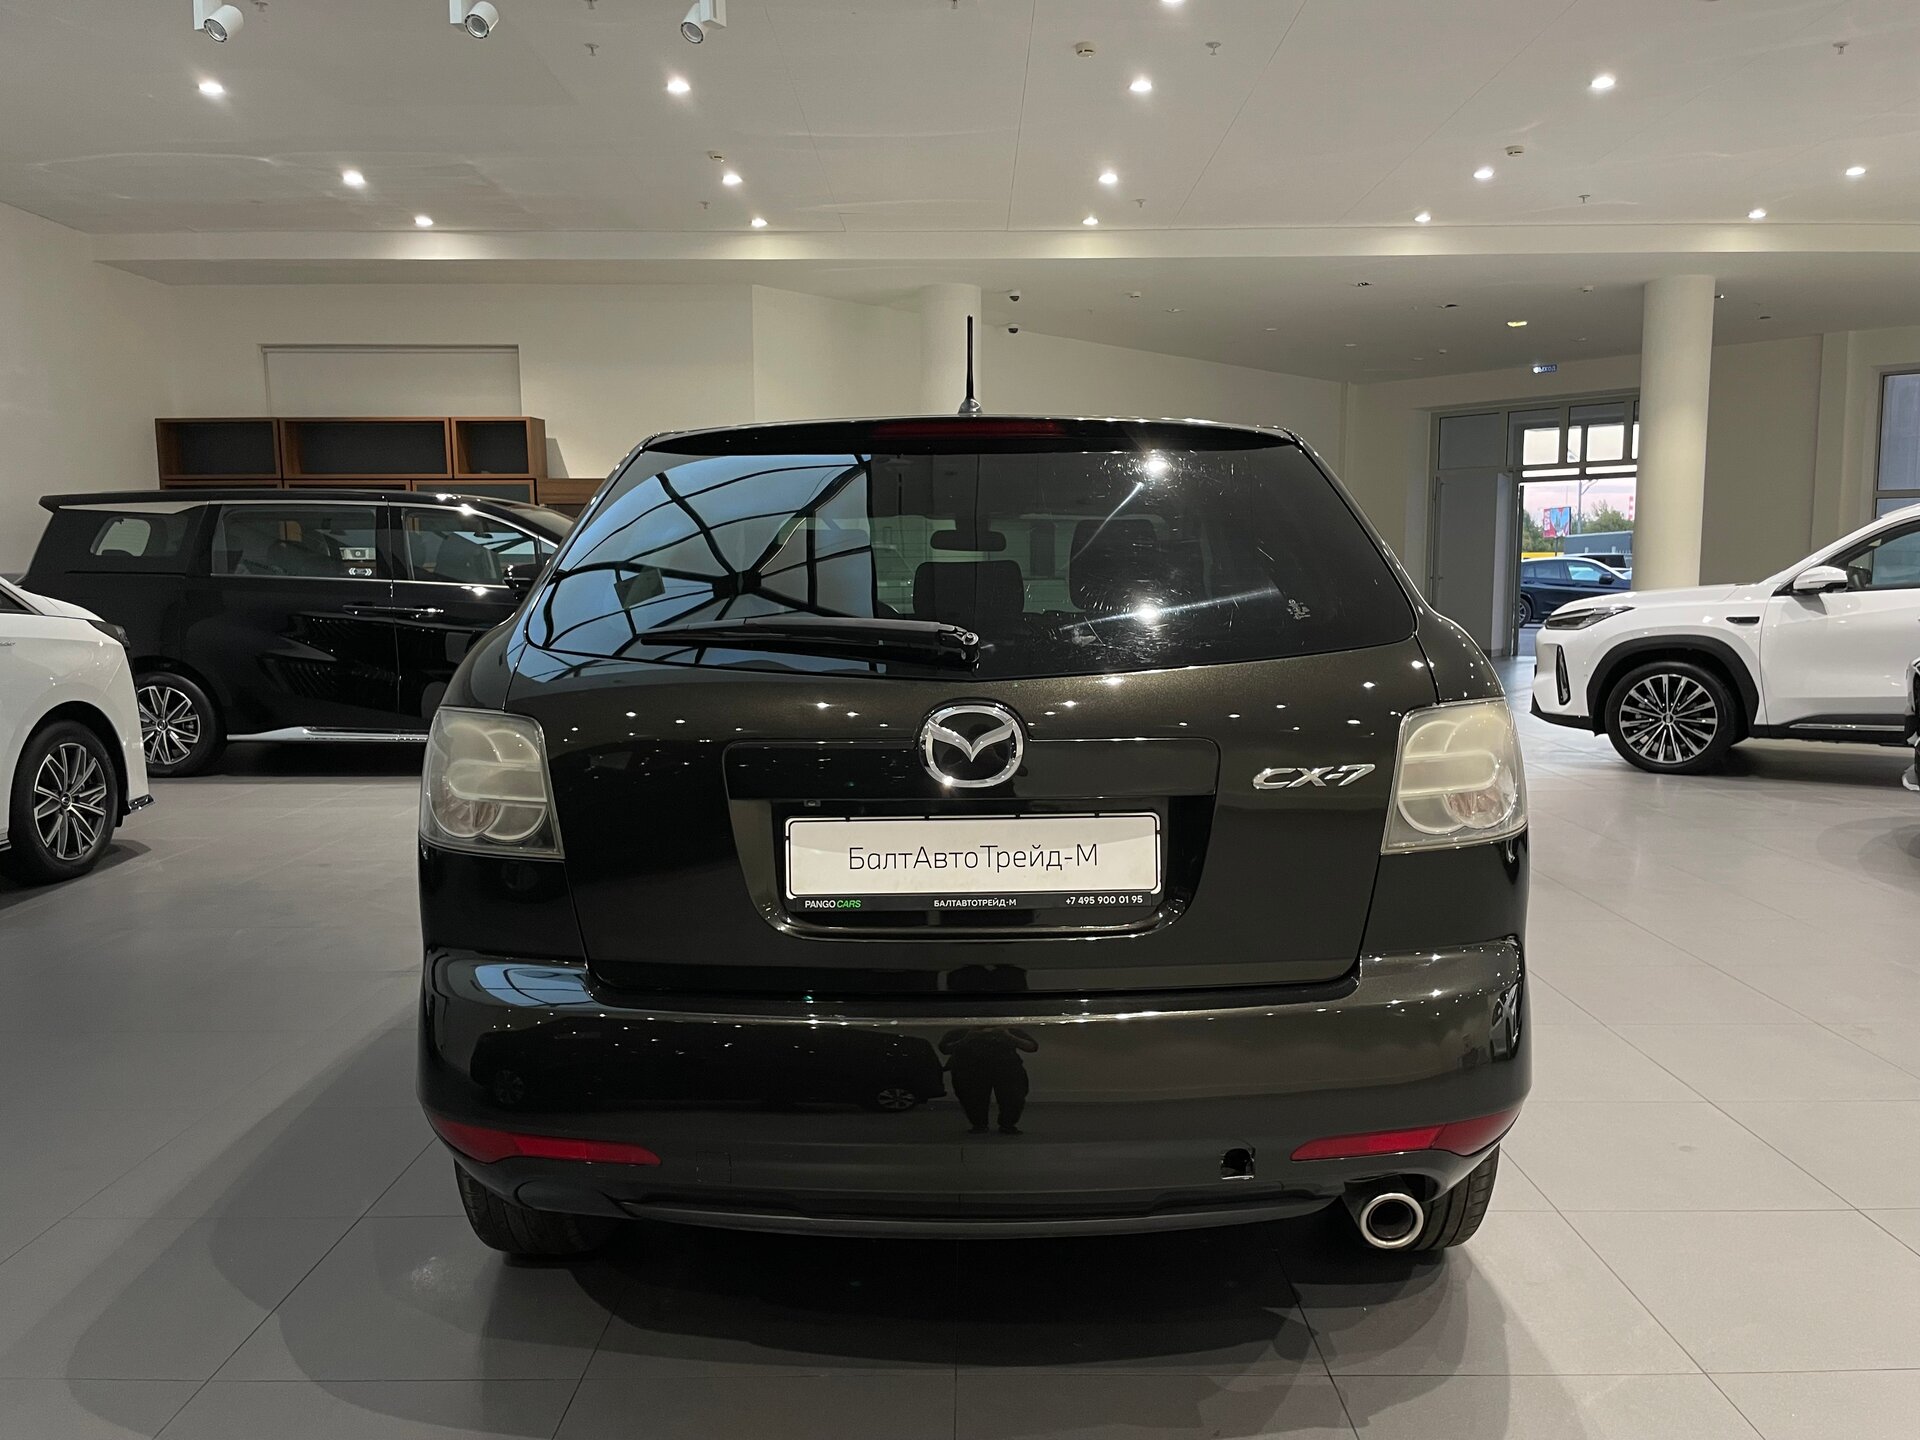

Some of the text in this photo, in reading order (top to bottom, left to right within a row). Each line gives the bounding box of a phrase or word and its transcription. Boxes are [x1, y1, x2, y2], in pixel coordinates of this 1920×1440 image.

[1252, 763, 1376, 790] CX-7
[849, 843, 1098, 873] БалтАвтоТрейд-М
[1065, 895, 1143, 905] +7 495 900 01 95
